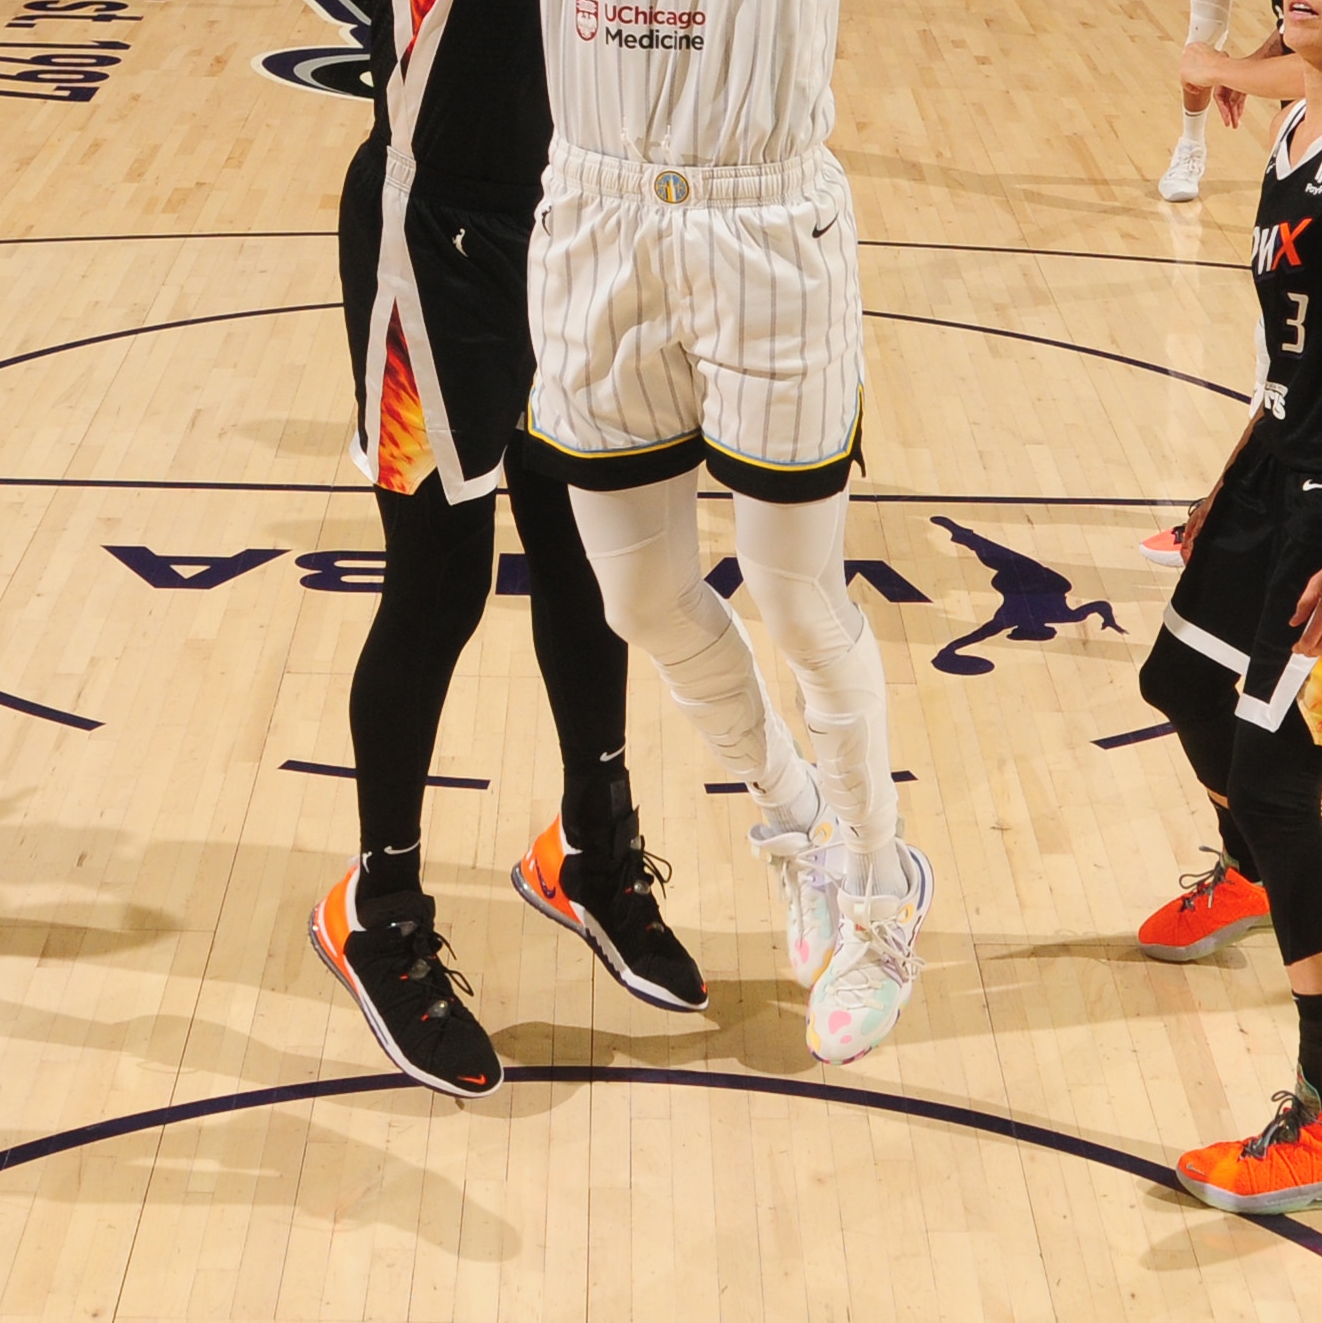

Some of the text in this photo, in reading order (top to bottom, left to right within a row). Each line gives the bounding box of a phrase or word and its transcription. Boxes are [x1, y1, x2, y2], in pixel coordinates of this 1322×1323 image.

[604, 5, 707, 30] UChicago
[604, 28, 705, 51] Medicine
[1281, 291, 1310, 354] 3
